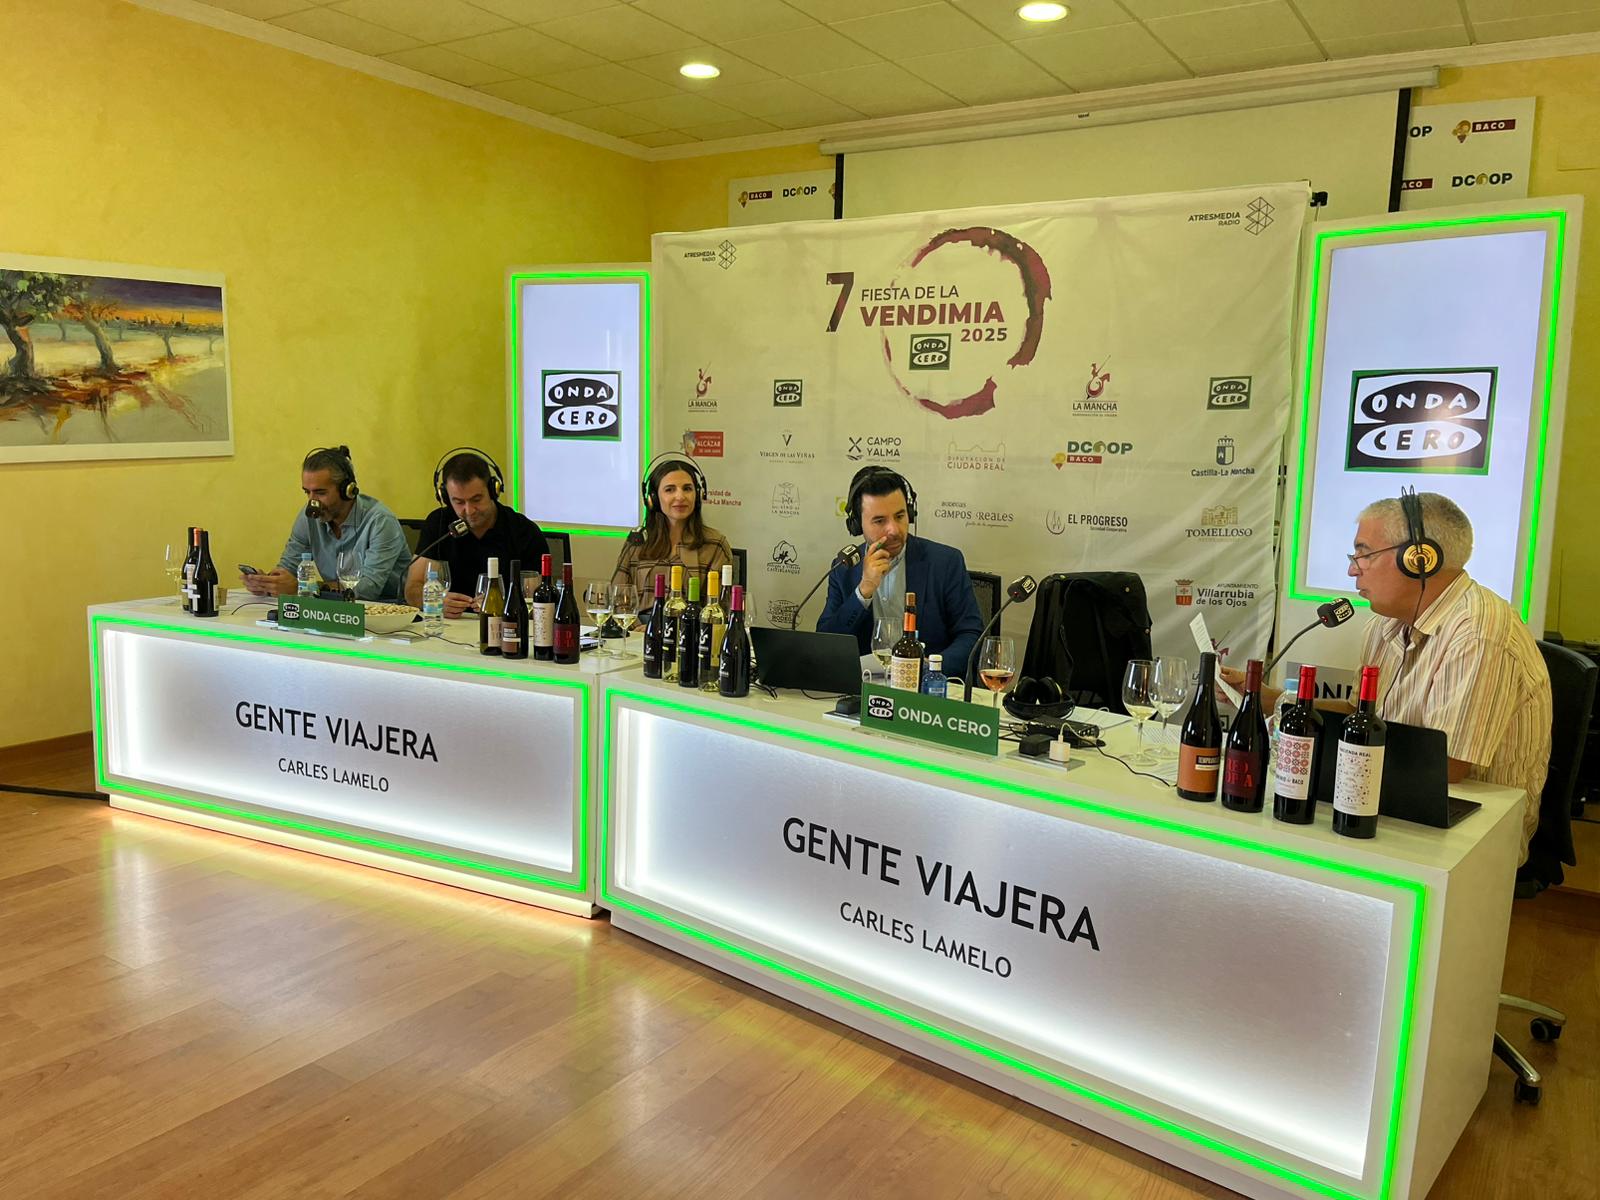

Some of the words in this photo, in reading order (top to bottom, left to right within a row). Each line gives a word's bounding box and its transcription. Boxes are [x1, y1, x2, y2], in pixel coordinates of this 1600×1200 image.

[1475, 121, 1506, 131] BACO
[1402, 180, 1423, 188] ACO
[1188, 212, 1240, 222] ATRESMEDIA
[861, 288, 910, 302] FIESTA
[914, 286, 936, 299] DE
[940, 285, 959, 298] LA
[825, 272, 854, 332] 7
[860, 301, 1005, 328] VENDIMIA
[960, 328, 1008, 342] 2025
[916, 342, 944, 350] ONDA
[917, 354, 943, 363] CERO
[554, 386, 608, 400] ONDA
[1215, 395, 1243, 403] CERO
[1072, 402, 1082, 410] LA
[1084, 402, 1118, 411] MANCHA
[1371, 392, 1468, 413] ONDA
[557, 411, 608, 425] CERO
[866, 436, 902, 446] CAMPO
[1374, 429, 1465, 451] CERO
[866, 448, 900, 457] YALMA
[947, 461, 981, 470] CIUDAD
[984, 462, 1004, 471] REAL
[1068, 514, 1078, 524] EL
[1080, 514, 1128, 527] PROGRESO
[1185, 528, 1252, 537] TOMELLOSO
[1197, 588, 1254, 599] Villarrubia
[1226, 598, 1247, 607] Ojos
[302, 609, 331, 622] ONDA
[333, 613, 360, 625] CERO
[898, 707, 943, 728] ONDA
[947, 717, 991, 737] CERO
[235, 701, 317, 740] GENTE
[325, 716, 438, 762] VIAJERA
[278, 758, 328, 780] CARLES
[333, 768, 389, 792] LAMELO
[783, 817, 901, 886] GENTE
[916, 854, 1100, 952] VIAJERA
[840, 902, 914, 944] CARLES
[922, 930, 1012, 978] LAMELO
